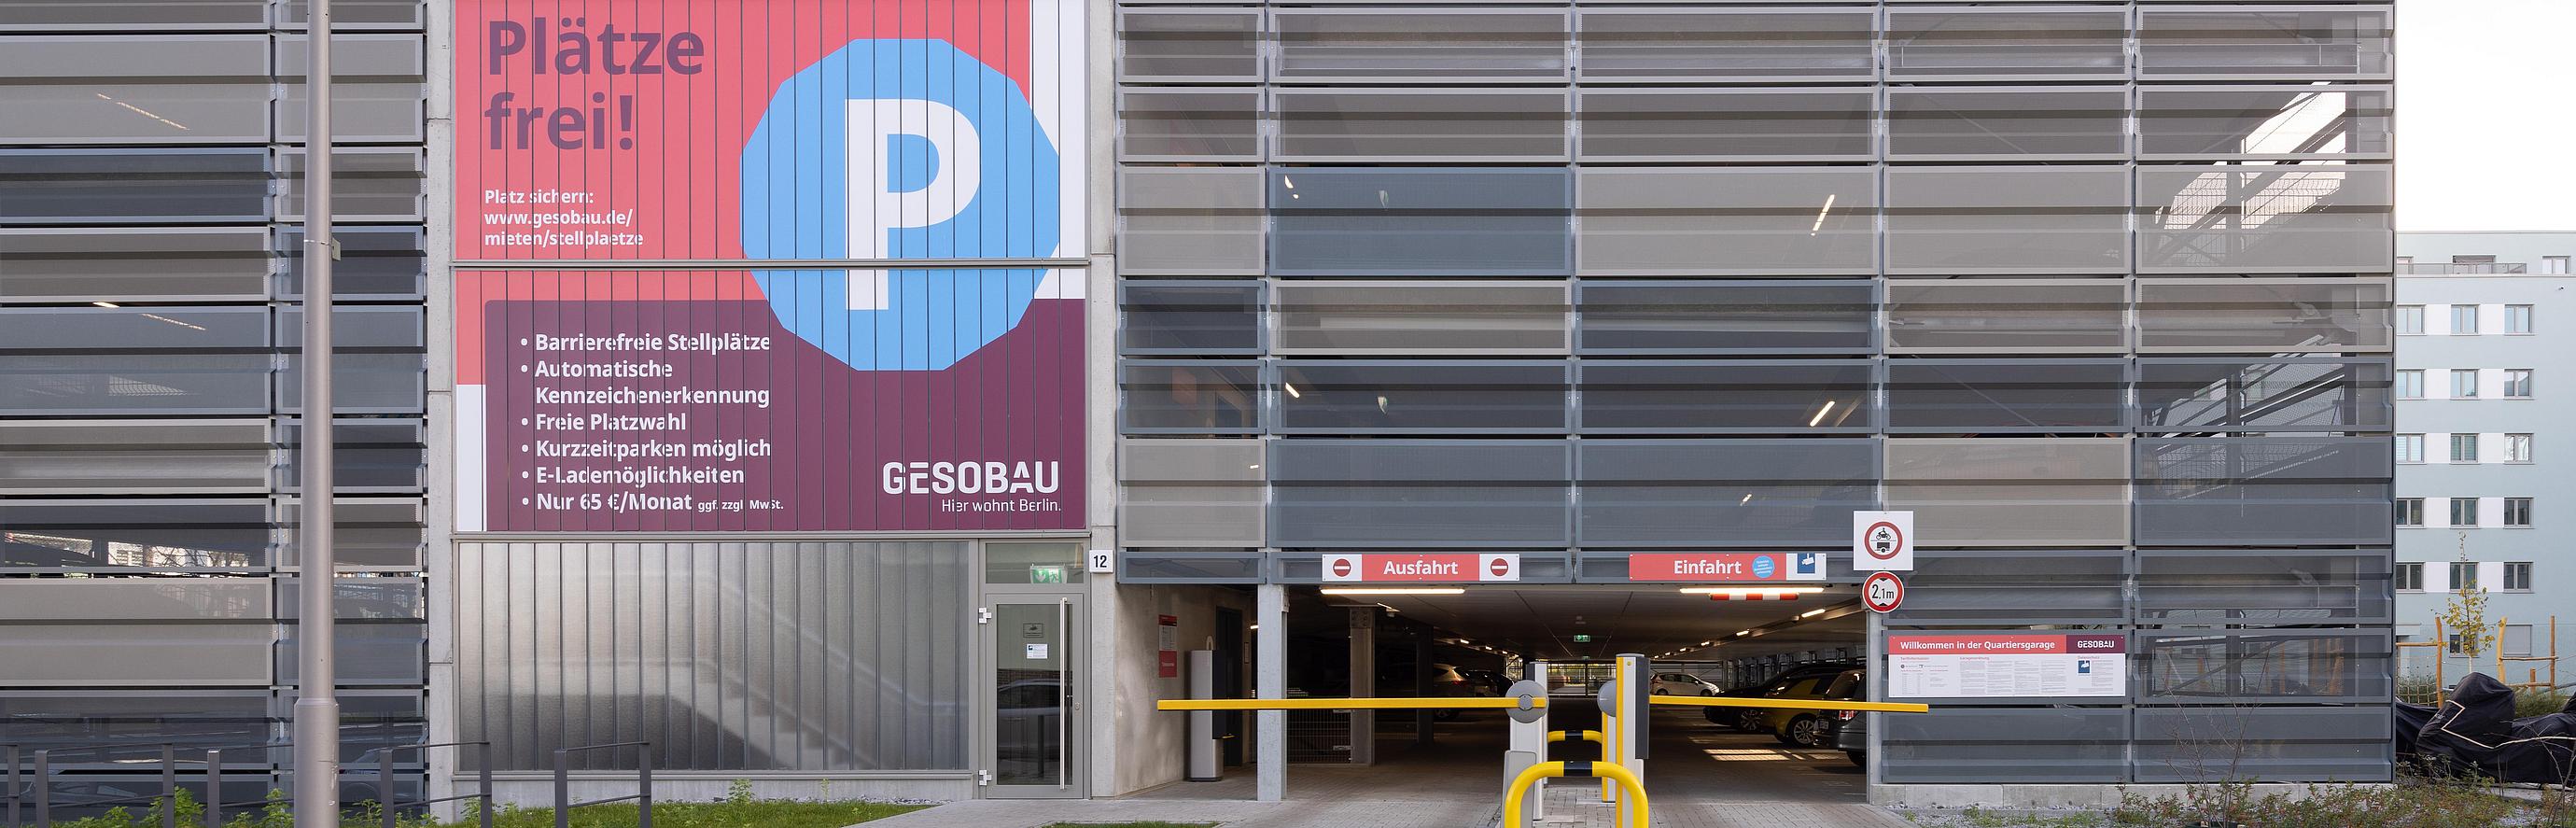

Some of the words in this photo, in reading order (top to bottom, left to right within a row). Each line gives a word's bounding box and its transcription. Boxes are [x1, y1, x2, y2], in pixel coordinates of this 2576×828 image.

[489, 17, 705, 76] Plätze
[484, 91, 634, 150] frei!
[484, 189, 525, 203] Platz
[529, 189, 594, 203] sichern:
[846, 99, 980, 310] P
[484, 209, 634, 227] www.gesobau.de/
[484, 231, 644, 249] mieten/stellplaetze
[536, 333, 663, 351] Barrierefreie
[667, 332, 770, 355] Stellplätze
[535, 360, 673, 378] Automatische
[536, 386, 770, 408] Kennzeichenerkennung
[536, 414, 584, 430] Freie
[591, 413, 686, 430] Platzwahl
[536, 440, 686, 461] Kurzzeitparken
[693, 439, 771, 461] möglich
[537, 466, 744, 487] E-Lademöglichkeiten
[883, 461, 1059, 494] GESOBAU
[537, 493, 575, 510] Nur
[580, 493, 602, 510] 65
[608, 492, 693, 513] €/Monat
[942, 499, 969, 512] Hier
[973, 498, 1015, 512] wohnt
[1019, 498, 1061, 512] Berlin.
[1093, 554, 1108, 568] 12
[1383, 560, 1458, 575] Ausfahrt
[1673, 560, 1742, 574] Einfahrt
[1900, 641, 1954, 650] Willkommen
[1956, 640, 1965, 649] in
[1967, 640, 1982, 649] der
[1984, 640, 2055, 650] Quartiersgarage
